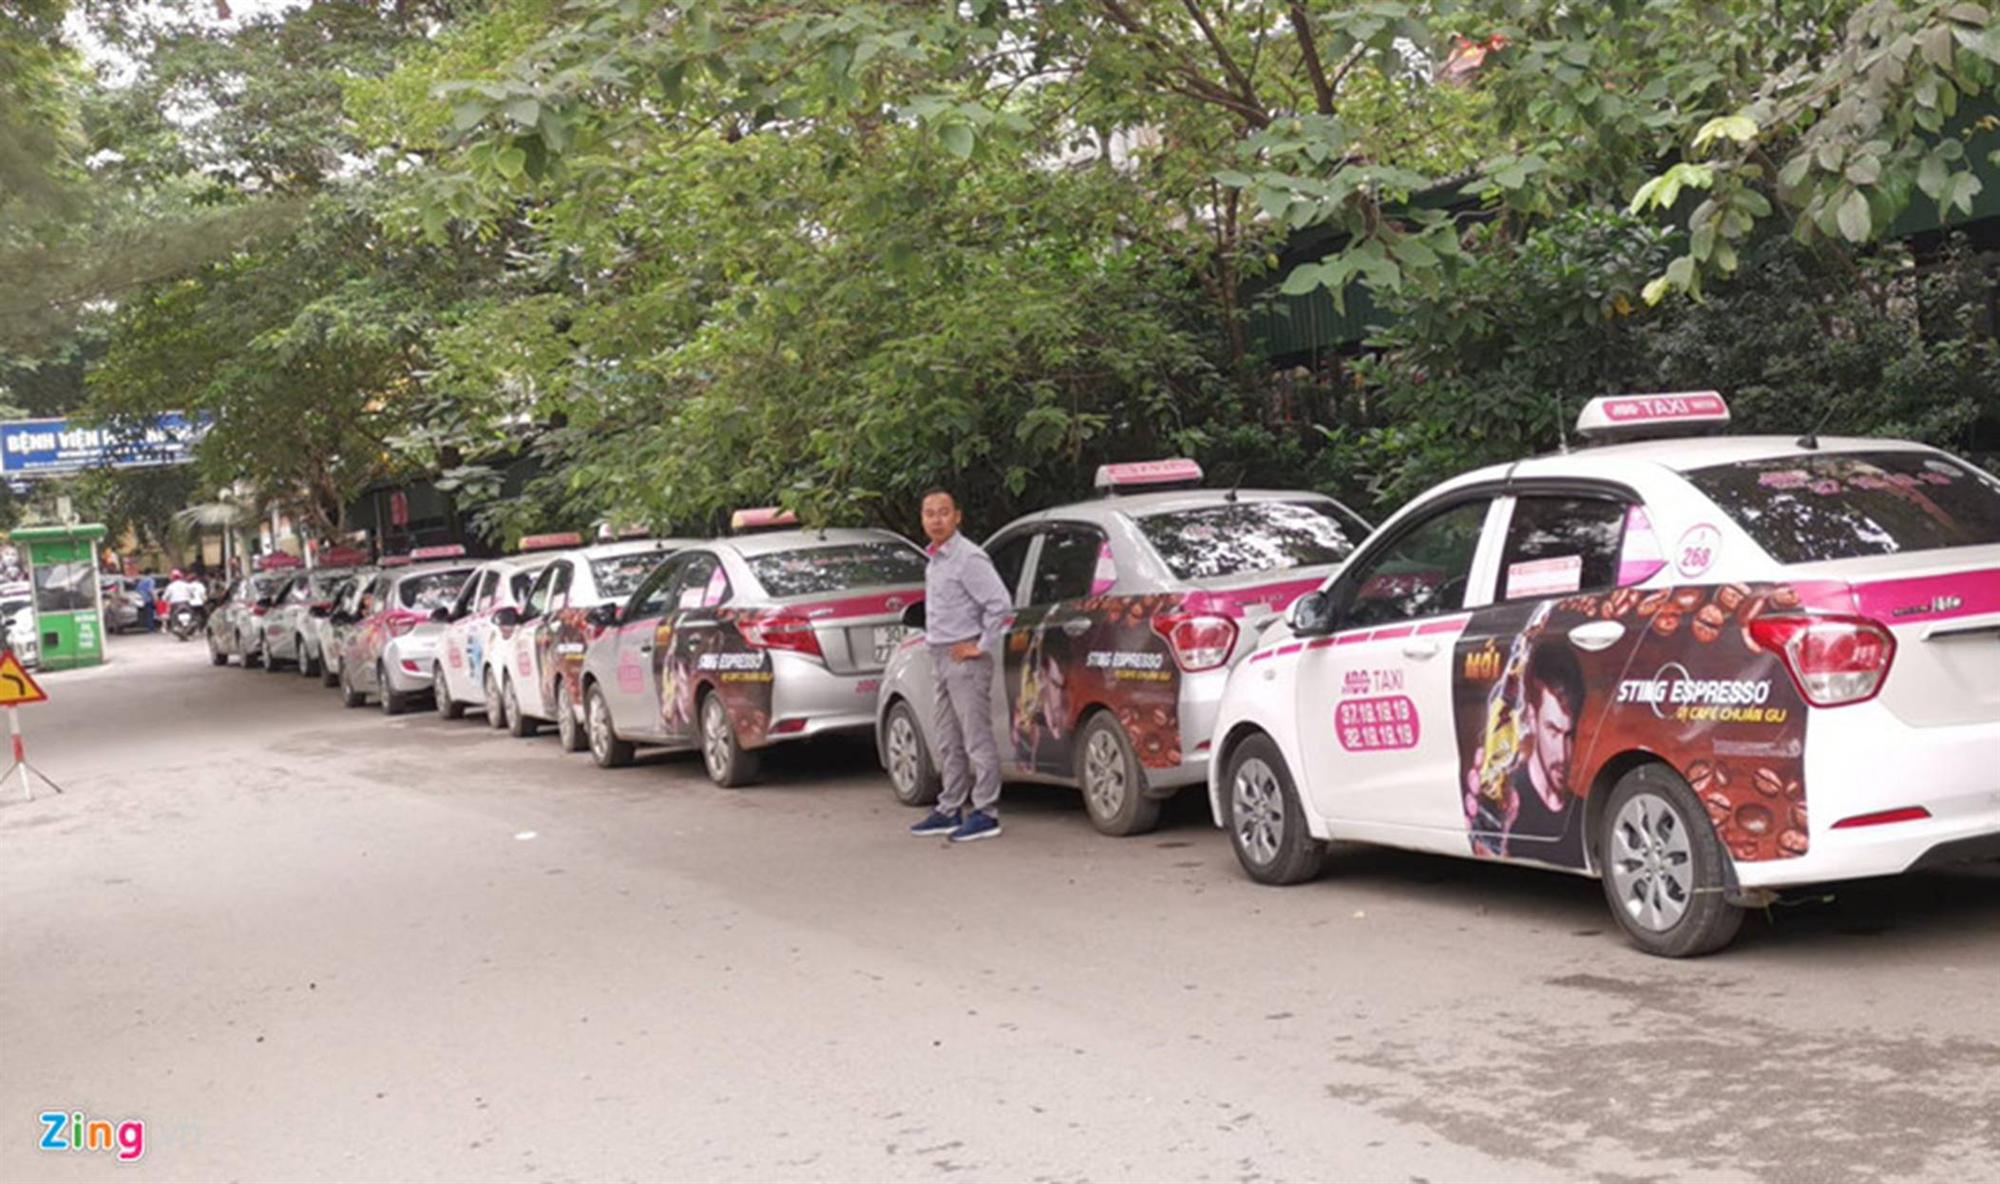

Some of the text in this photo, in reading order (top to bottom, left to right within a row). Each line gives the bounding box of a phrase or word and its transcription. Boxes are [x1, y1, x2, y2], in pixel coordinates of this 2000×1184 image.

[1638, 399, 1690, 416] TAXI
[1682, 547, 1711, 567] 268
[1373, 669, 1405, 692] TAXI
[1617, 680, 1770, 704] STING ESPRESSO
[1765, 708, 1787, 722] GU
